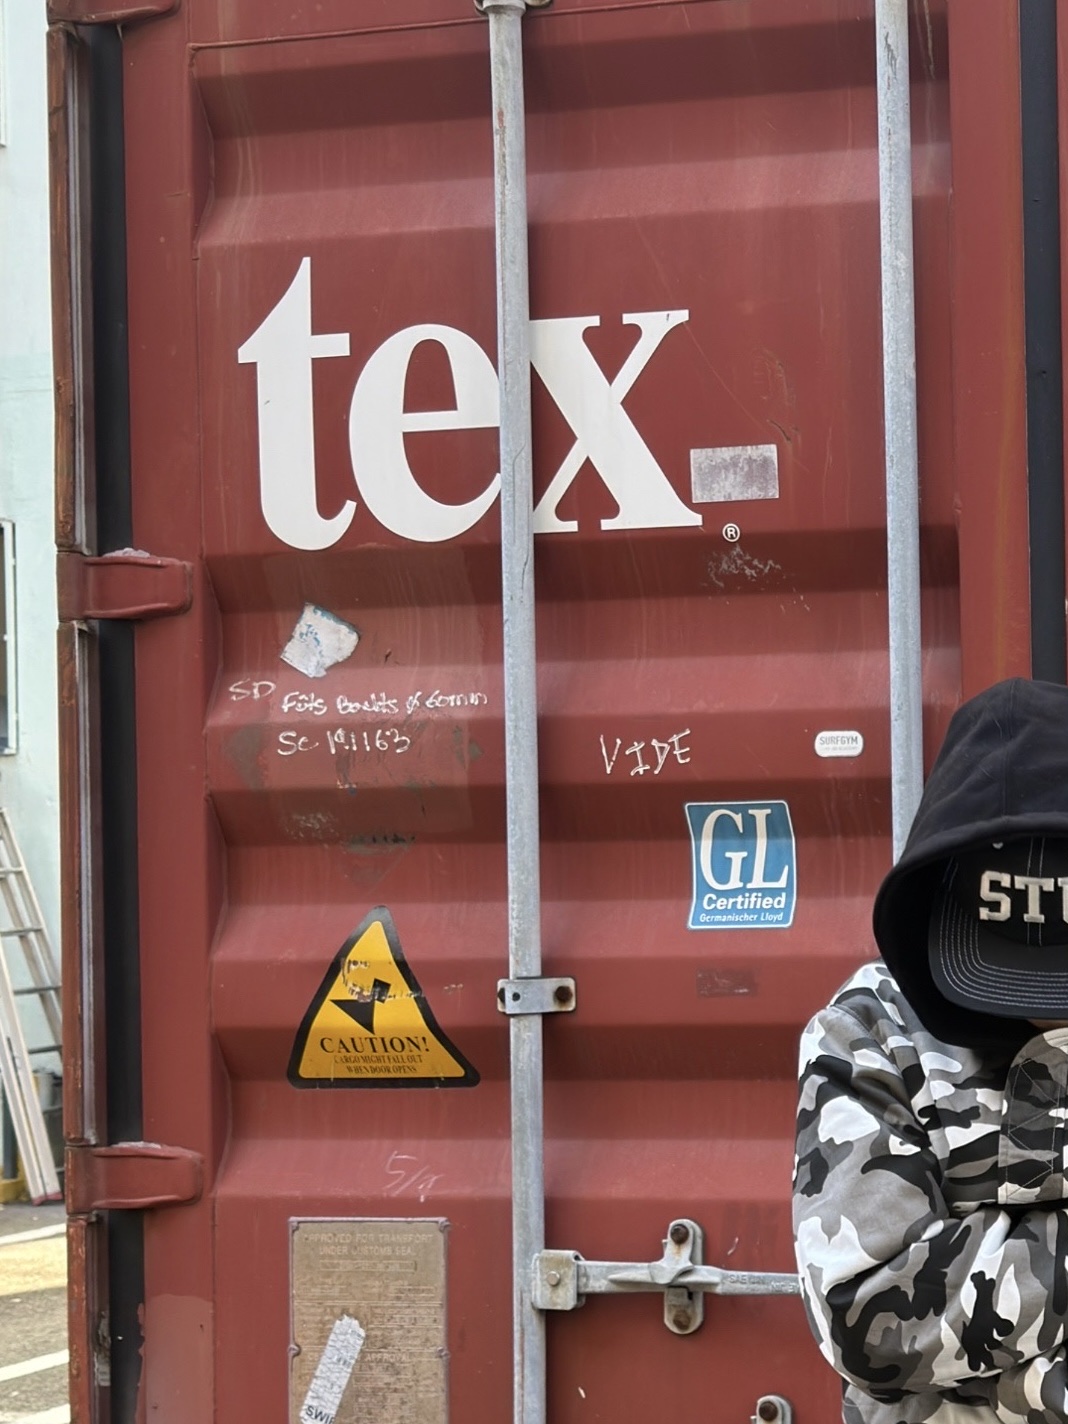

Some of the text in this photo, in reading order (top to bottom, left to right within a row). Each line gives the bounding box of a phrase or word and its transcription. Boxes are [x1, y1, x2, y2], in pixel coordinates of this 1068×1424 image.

[238, 256, 702, 551] tex
[600, 728, 691, 776] VIDE
[701, 809, 788, 890] GL
[699, 911, 784, 923] Germanischer Lloyd
[703, 892, 786, 910] Certified
[320, 1036, 430, 1053] CAUTION!
